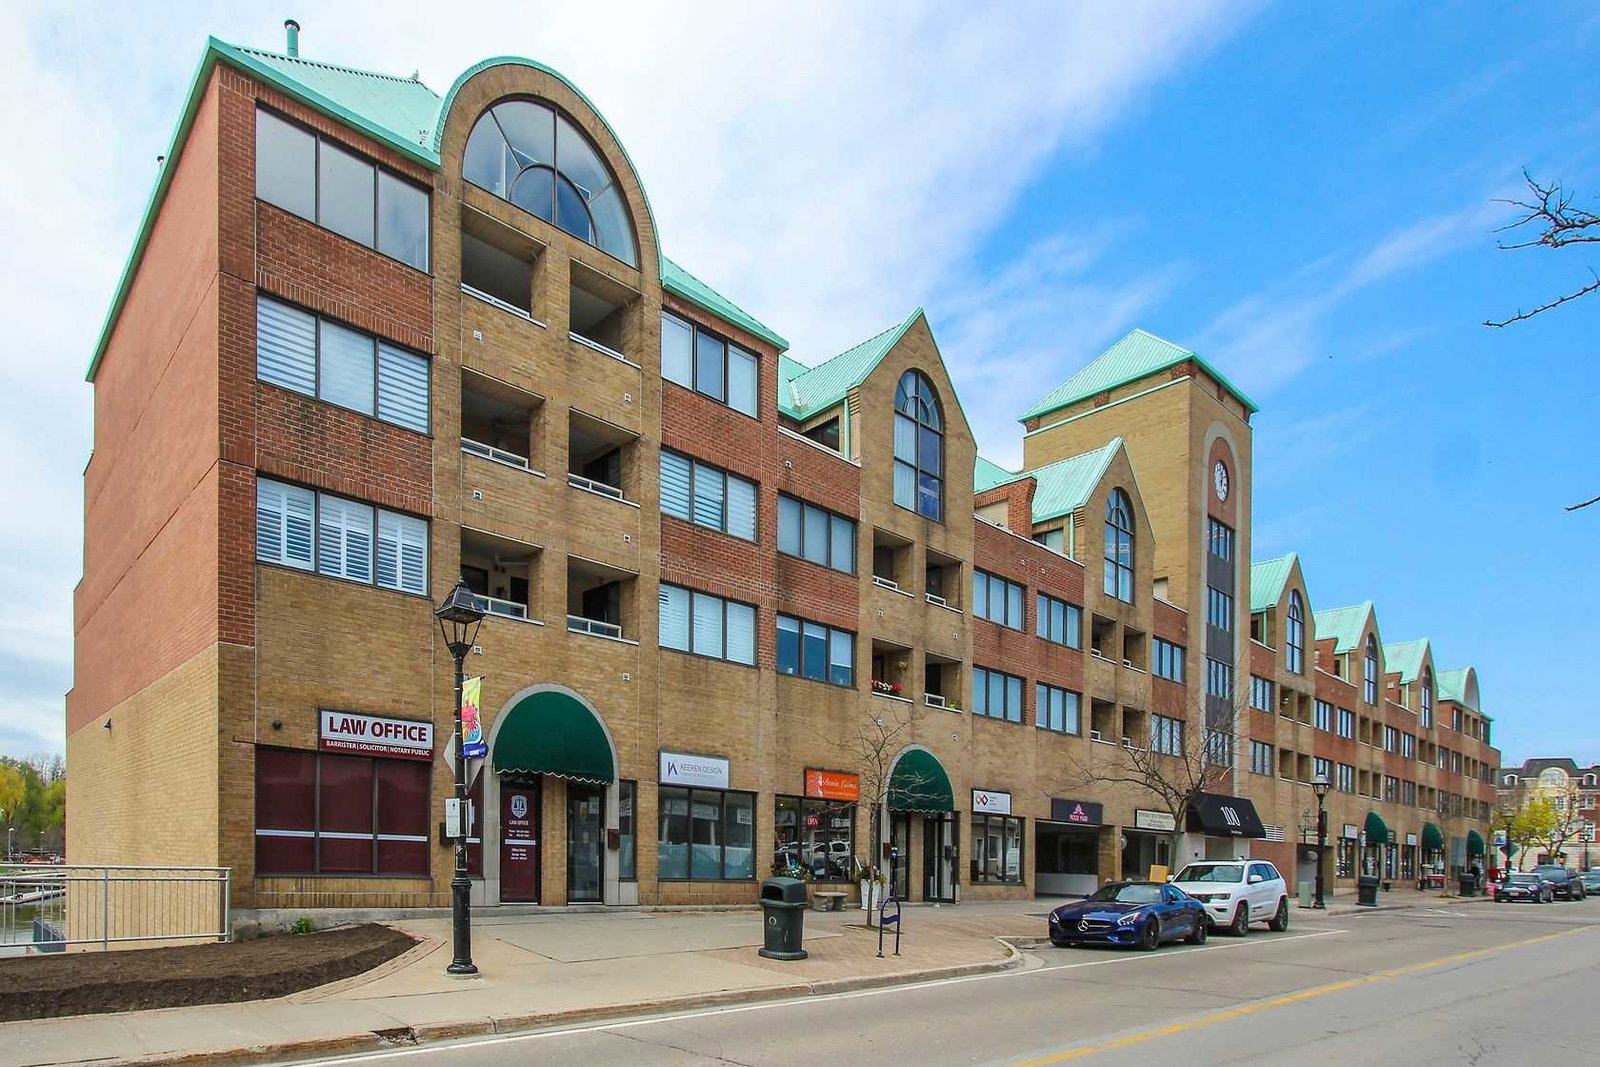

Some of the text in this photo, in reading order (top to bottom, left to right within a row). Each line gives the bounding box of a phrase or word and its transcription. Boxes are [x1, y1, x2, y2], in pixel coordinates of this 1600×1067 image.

[329, 716, 427, 742] LAW OFFICE
[326, 740, 356, 749] BARRISTER
[359, 743, 388, 752] SOLICITOR
[390, 746, 411, 755] NOTARY
[1220, 806, 1241, 827] 100
